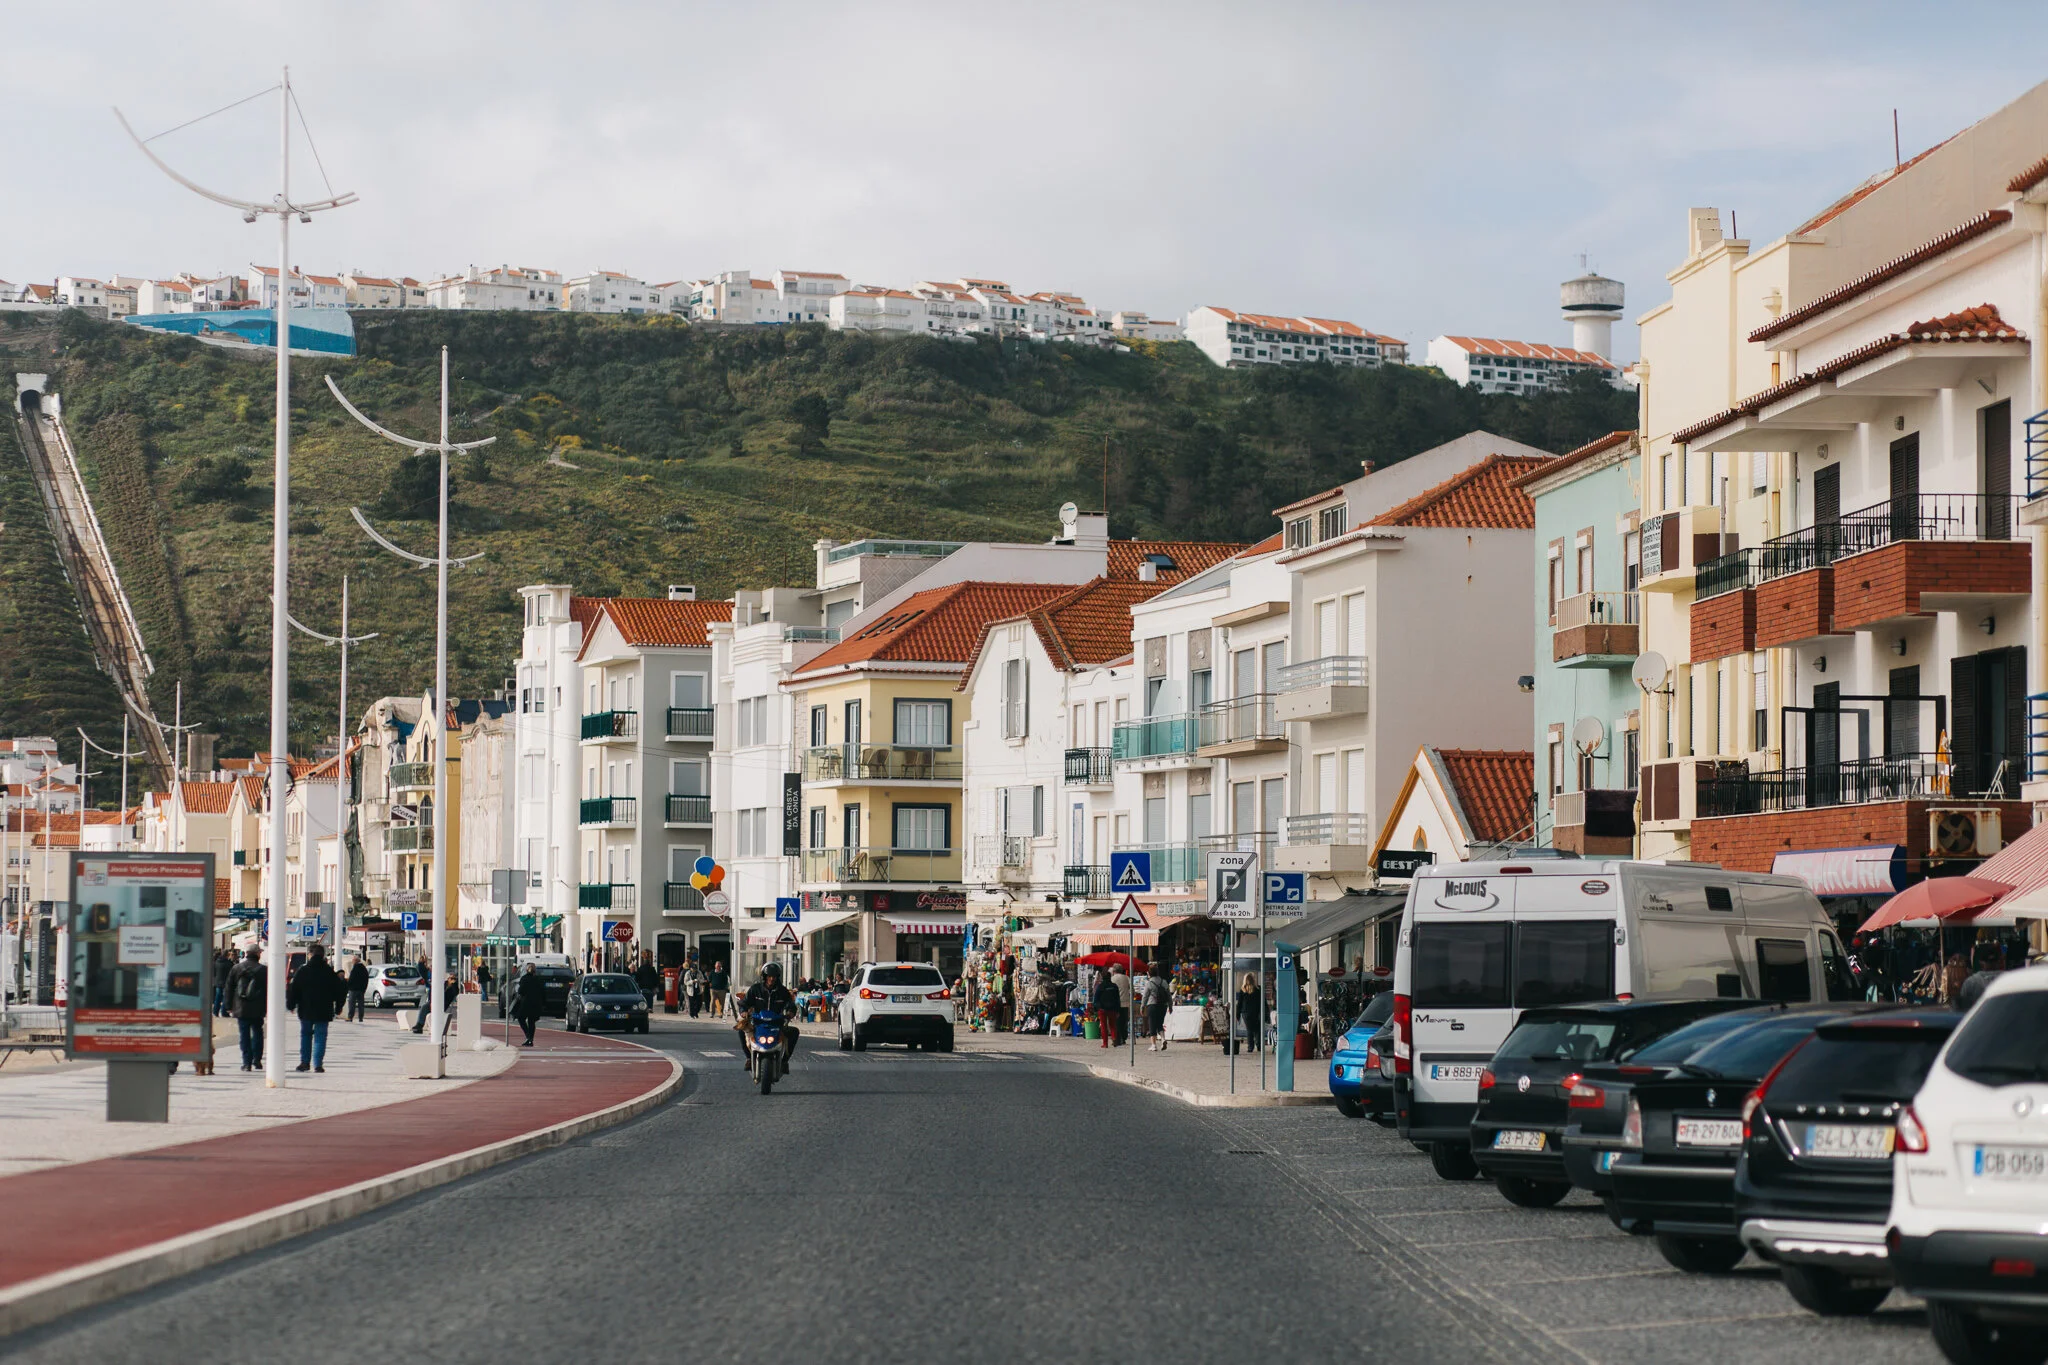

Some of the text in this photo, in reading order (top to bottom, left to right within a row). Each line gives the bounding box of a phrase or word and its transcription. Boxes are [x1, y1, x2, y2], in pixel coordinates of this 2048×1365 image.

[786, 819, 793, 831] NA
[792, 816, 799, 828] DA
[1220, 857, 1244, 865] zona
[1222, 871, 1241, 900] P
[1266, 875, 1285, 901] P
[404, 913, 415, 929] P
[304, 926, 312, 936] P
[614, 928, 633, 937] STOP
[1282, 956, 1291, 969] P
